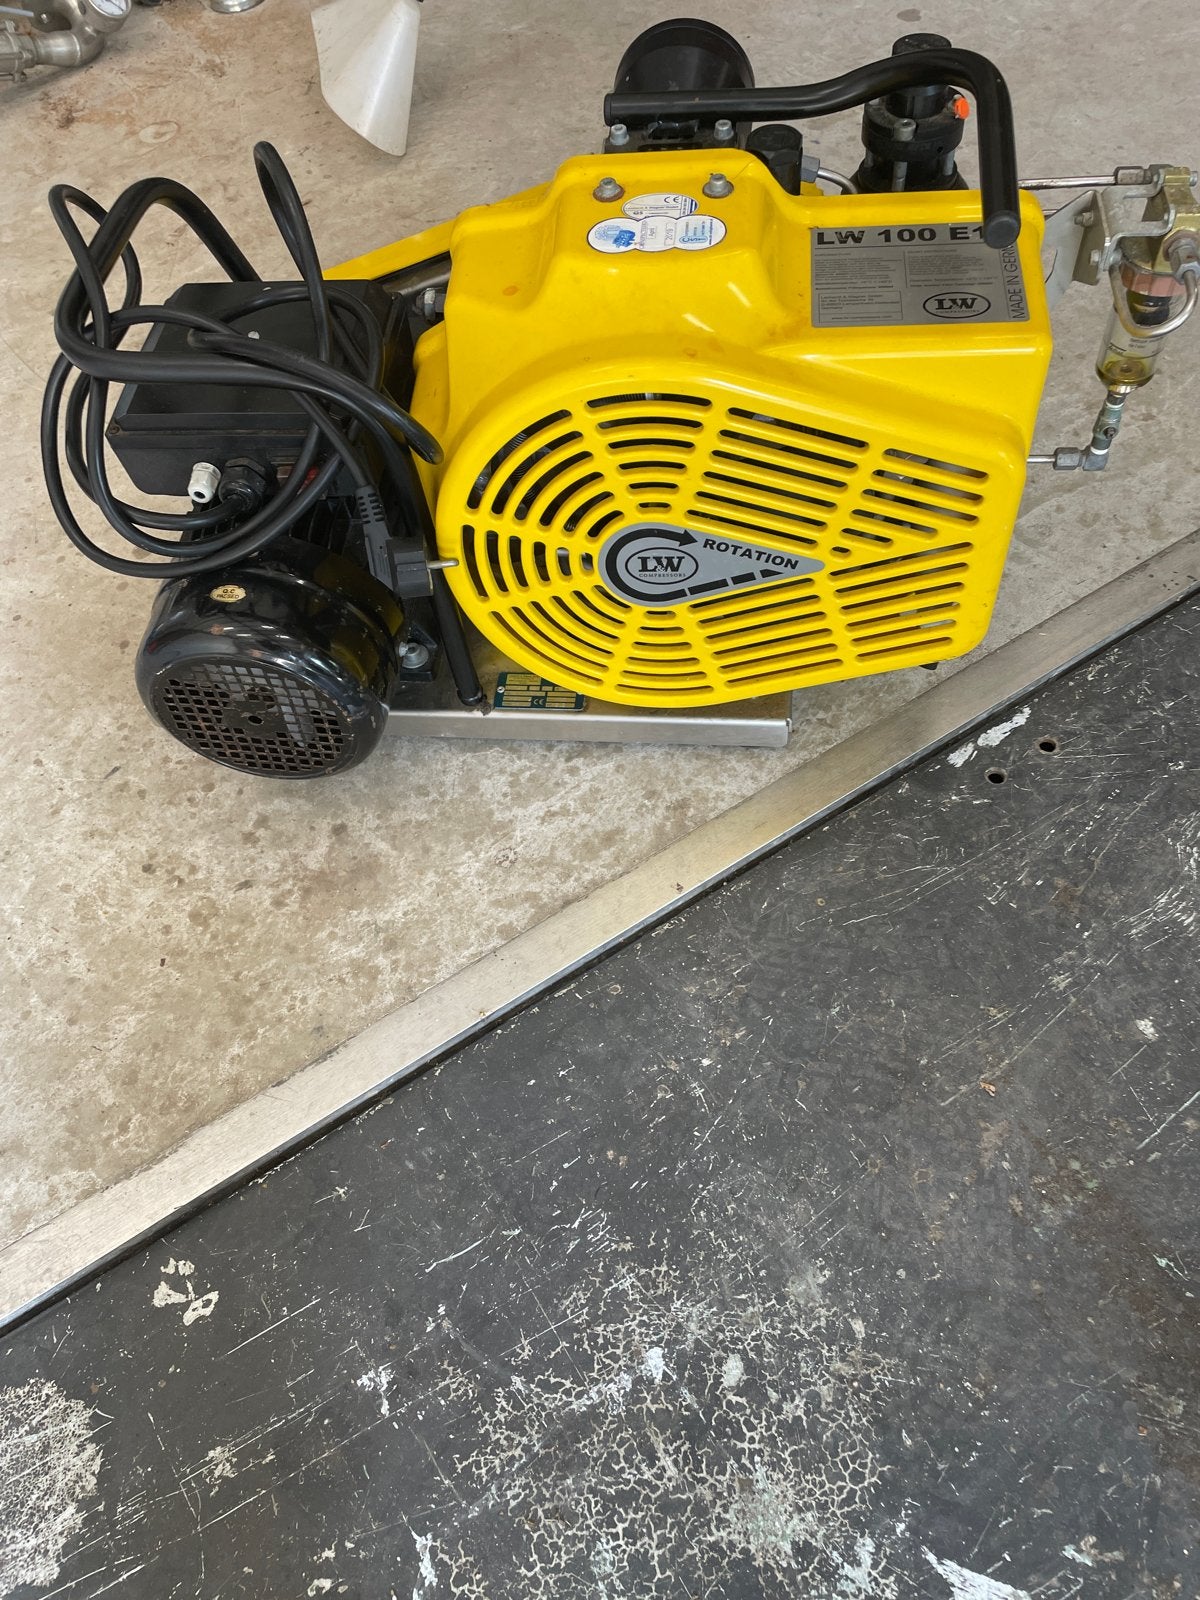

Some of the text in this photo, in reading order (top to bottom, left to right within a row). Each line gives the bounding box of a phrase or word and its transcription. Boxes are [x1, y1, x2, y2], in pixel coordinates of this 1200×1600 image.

[817, 230, 865, 245] LW
[877, 227, 937, 243] 100
[1005, 275, 1020, 286] IN
[1008, 288, 1026, 319] MADE
[702, 538, 799, 570] ROTATION
[637, 556, 685, 572] L&W
